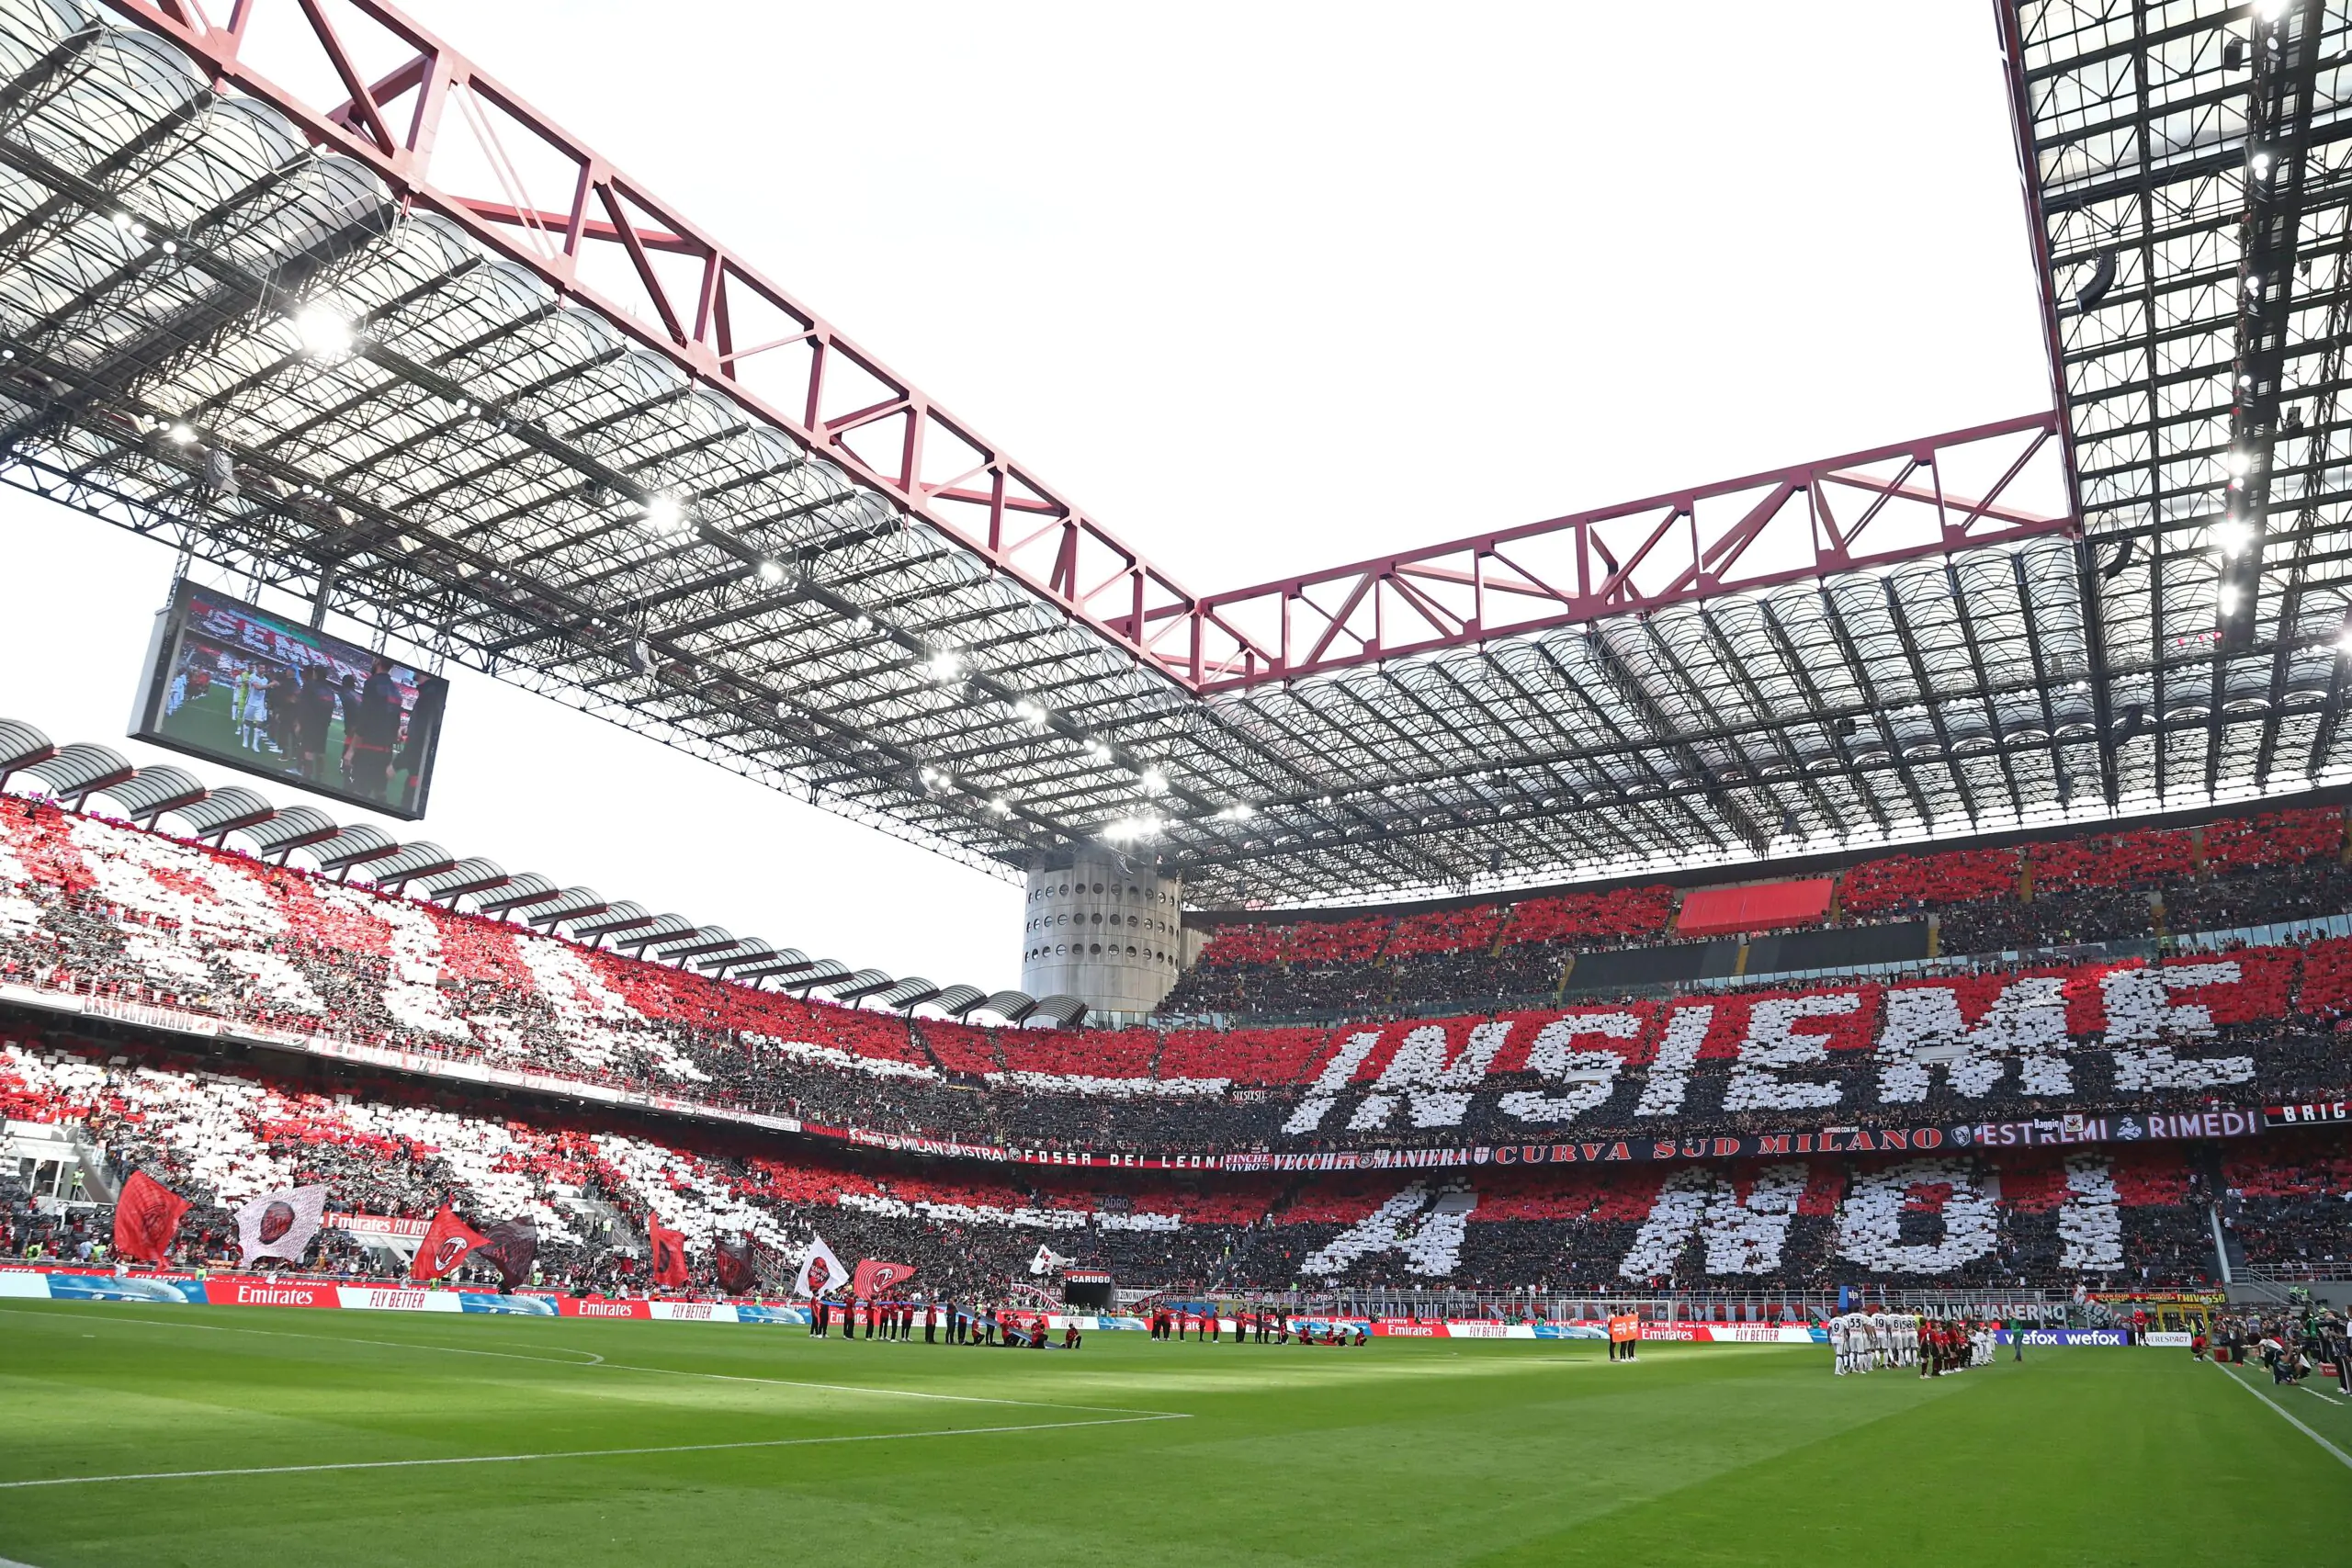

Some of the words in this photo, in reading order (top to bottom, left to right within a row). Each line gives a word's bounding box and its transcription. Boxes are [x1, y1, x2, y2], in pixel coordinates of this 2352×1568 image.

[1281, 961, 2255, 1134] INSIEME
[2282, 1102, 2346, 1122] BRIG
[806, 1122, 844, 1139] VIADANA
[2148, 1111, 2256, 1138] RIMEDI
[859, 1133, 884, 1146] Angelo
[1494, 1141, 1631, 1165] CURVA
[1654, 1137, 1740, 1159] SUD
[1758, 1127, 1943, 1154] MILANO
[900, 1136, 944, 1156] MILAN
[961, 1146, 1004, 1163] ISTRA
[1024, 1149, 1091, 1165] FOSSA
[1110, 1154, 1144, 1167] DEI
[1161, 1155, 1224, 1168] LEONI
[1273, 1152, 1356, 1171] VECCHIA
[1373, 1147, 1468, 1169] MANIERA
[1104, 1198, 1129, 1209] ADRO
[1301, 1179, 1476, 1277] A
[1619, 1151, 2124, 1277] NOI
[327, 1213, 391, 1234] Emirates
[394, 1218, 410, 1235] FLY
[411, 1221, 431, 1236] BETT
[1071, 1275, 1111, 1284] CARUGO
[237, 1285, 314, 1306] Emirates
[369, 1291, 387, 1308] FLY
[389, 1292, 425, 1310] BETTER
[578, 1300, 633, 1316] Emirates
[672, 1303, 686, 1318] FLY
[686, 1304, 712, 1320] BETTER
[1834, 1323, 1840, 1333] 9
[1849, 1317, 1861, 1328] 33
[1875, 1317, 1884, 1328] 19
[1894, 1319, 1899, 1328] 6
[1388, 1325, 1433, 1337] Emirates
[1470, 1325, 1482, 1337] FLY
[1482, 1326, 1508, 1337] BETTER
[1642, 1328, 1693, 1341] Emirates
[1736, 1329, 1750, 1341] FLY
[1750, 1329, 1780, 1342] BETTER
[2065, 1330, 2120, 1346] wefox
